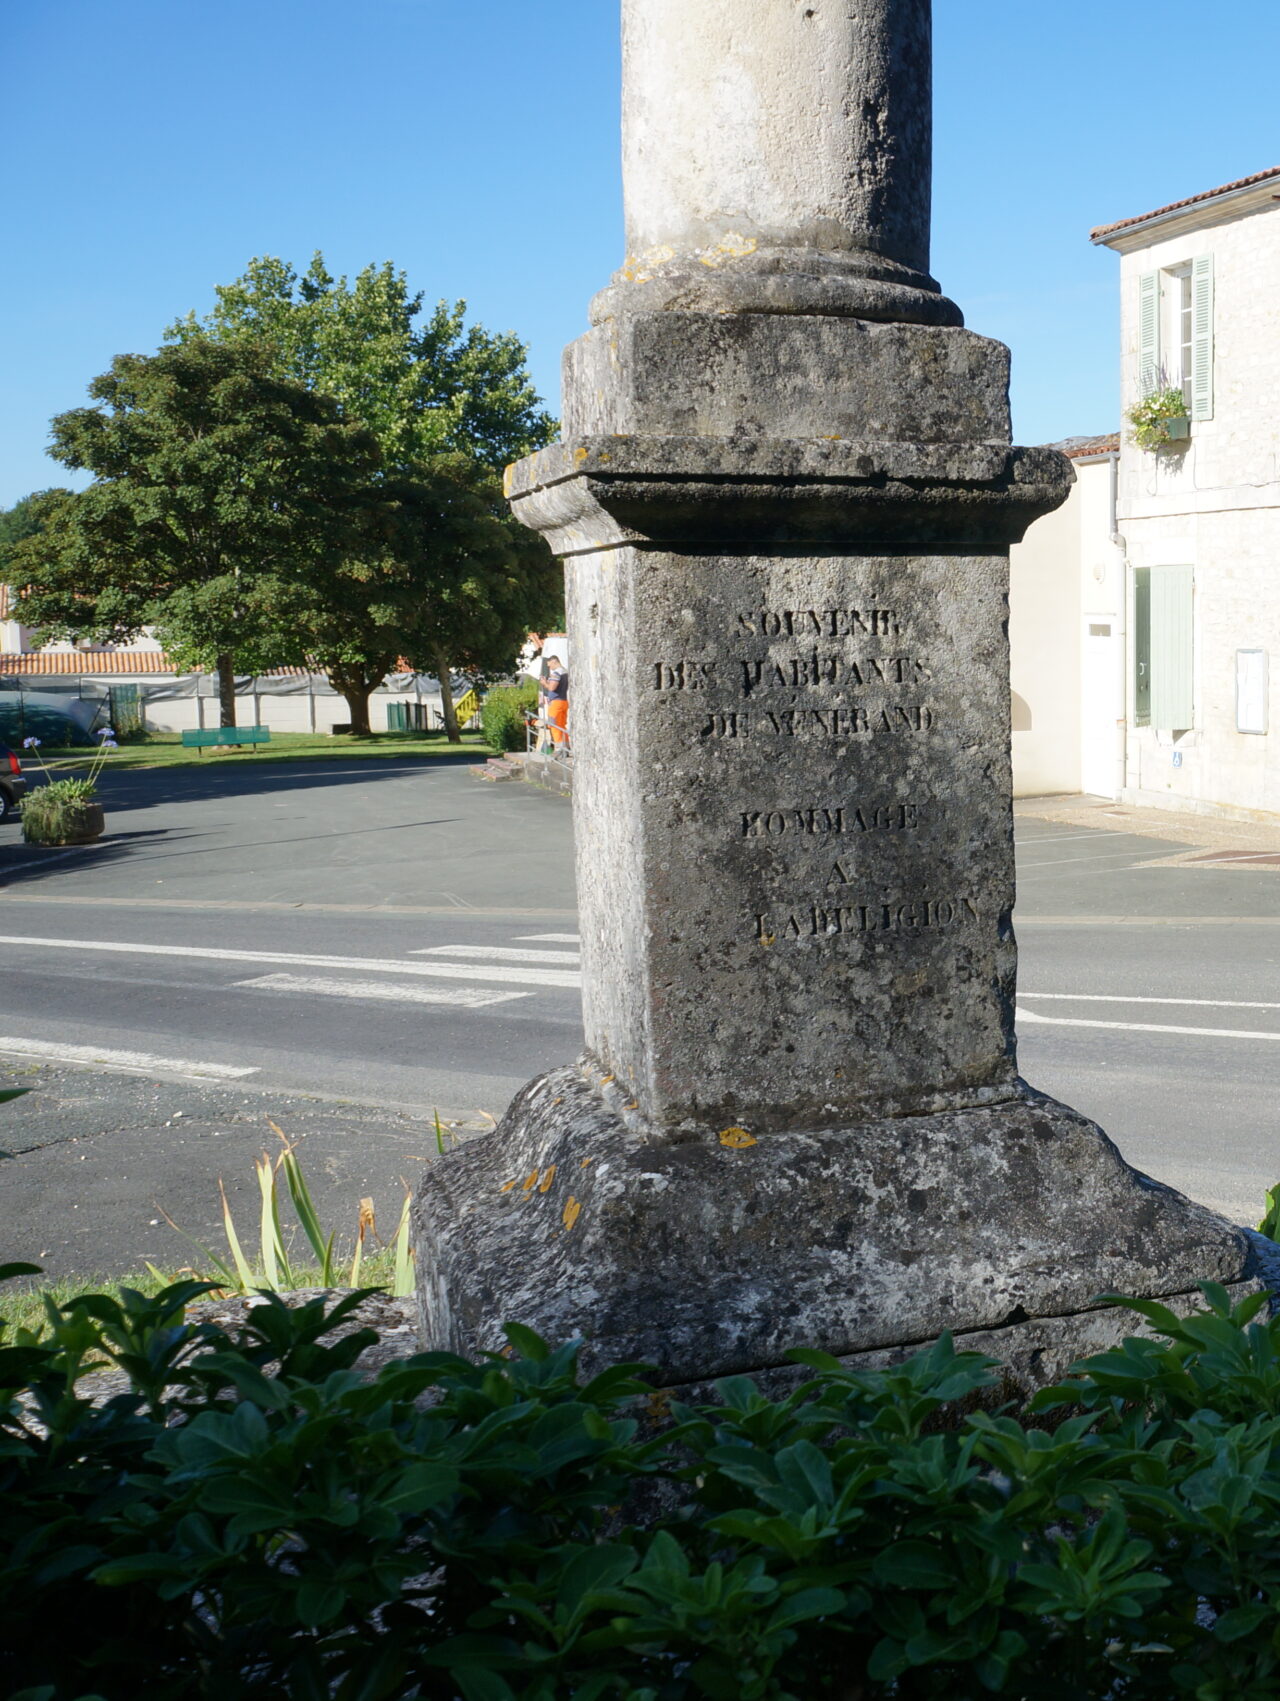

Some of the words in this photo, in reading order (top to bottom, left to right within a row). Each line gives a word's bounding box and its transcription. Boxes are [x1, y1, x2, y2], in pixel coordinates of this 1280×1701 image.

[736, 610, 901, 638] SOUVENIR
[654, 659, 717, 691] DES
[740, 654, 934, 697] HABITANTS
[702, 712, 749, 740] DE
[739, 803, 919, 838] HOMMAGE
